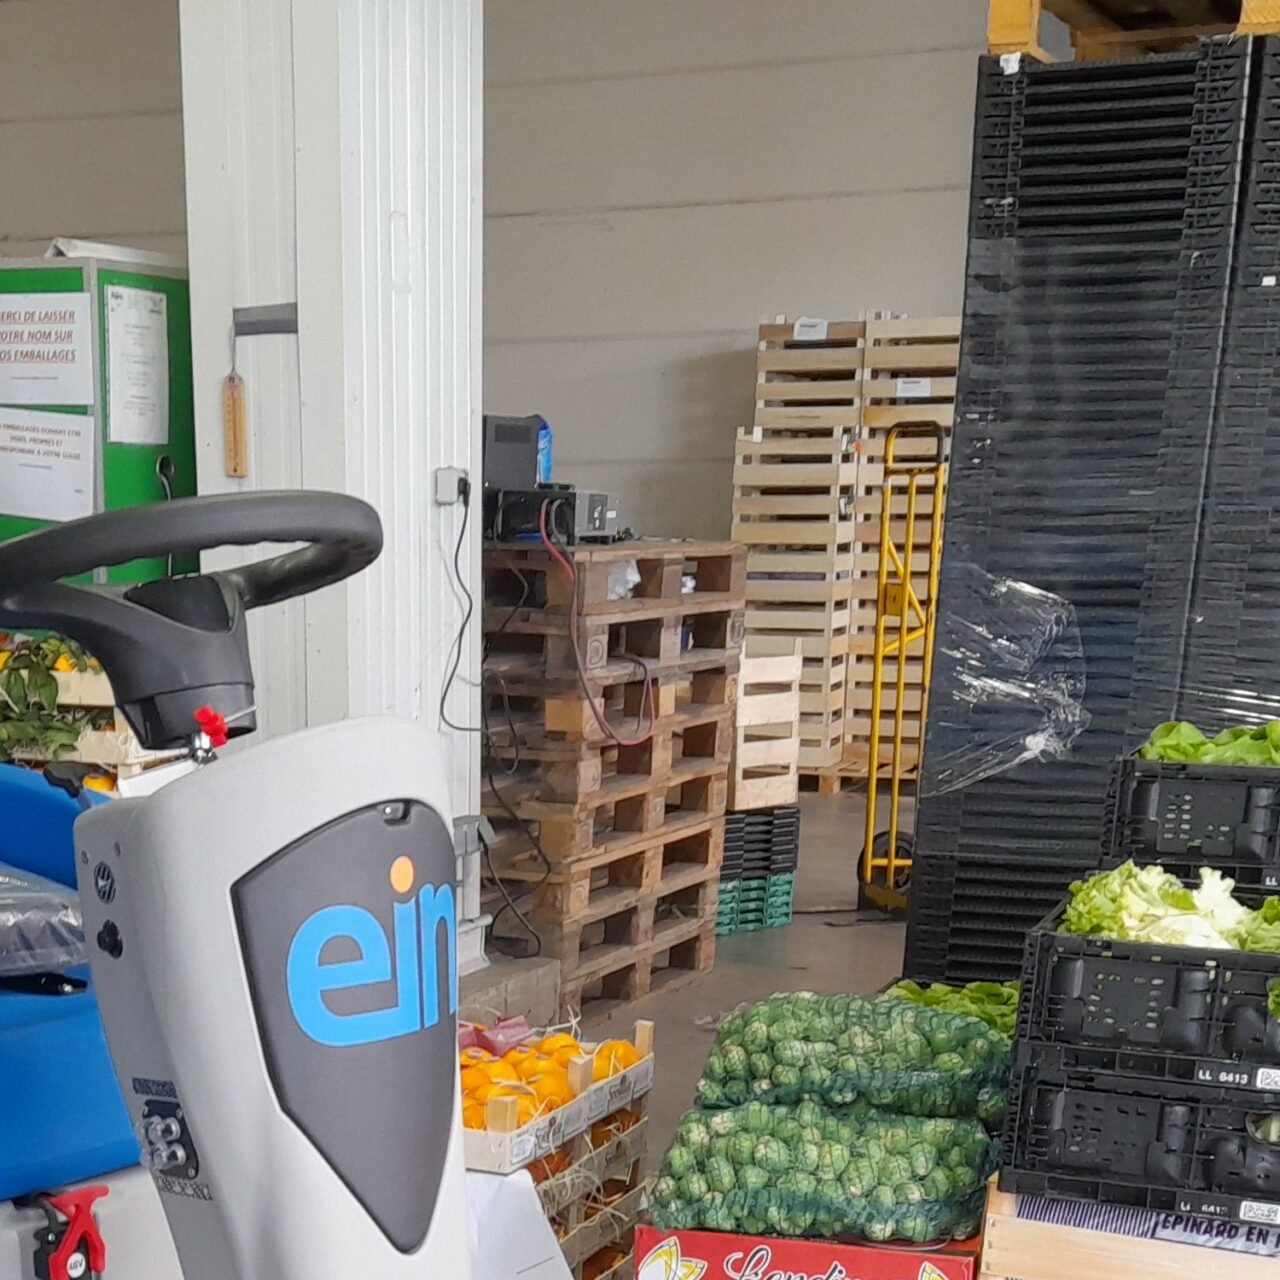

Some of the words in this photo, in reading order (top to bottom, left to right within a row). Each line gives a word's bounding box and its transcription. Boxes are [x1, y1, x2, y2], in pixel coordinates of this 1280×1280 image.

[23, 310, 37, 322] DE
[38, 310, 76, 323] LAISSER
[27, 329, 52, 342] NOM
[54, 329, 73, 342] SUR
[14, 349, 76, 362] EMBALLAGES
[286, 855, 458, 1047] ein
[1198, 1069, 1213, 1081] LL
[1218, 1072, 1249, 1085] 6413
[1161, 1213, 1240, 1240] EPINARD
[1245, 1225, 1270, 1246] EN
